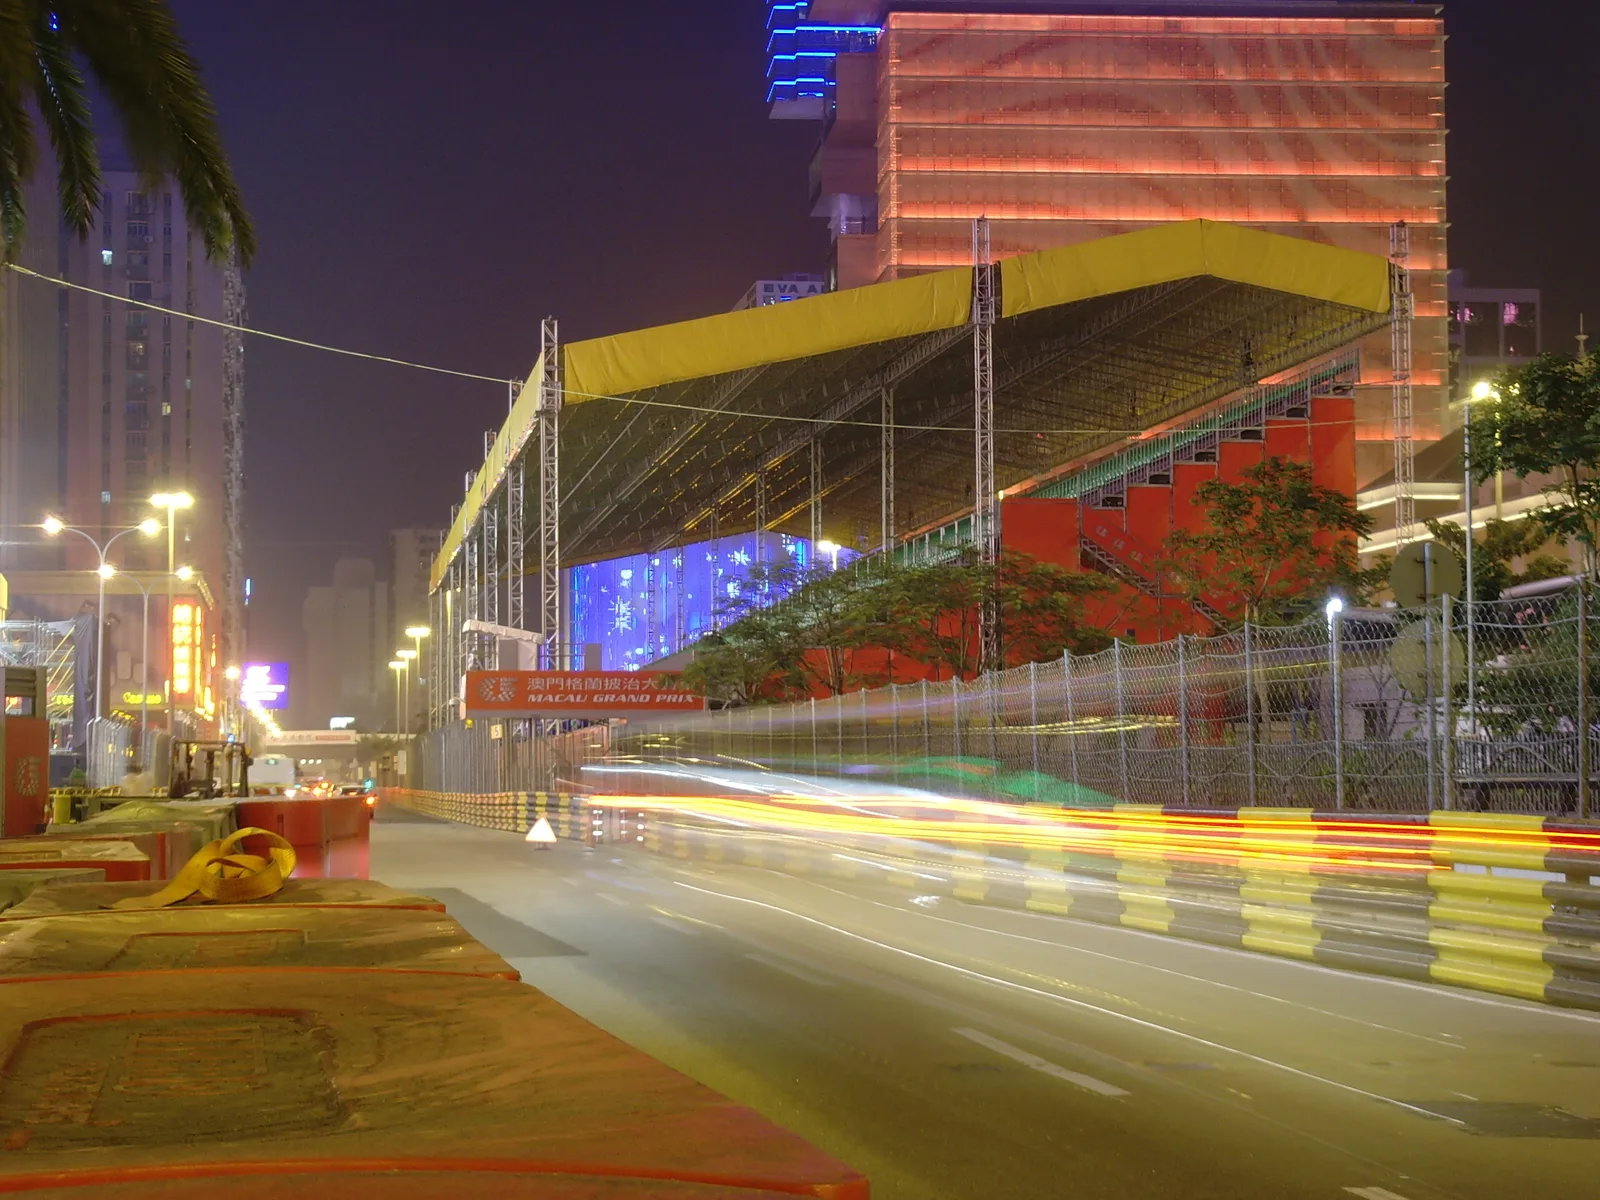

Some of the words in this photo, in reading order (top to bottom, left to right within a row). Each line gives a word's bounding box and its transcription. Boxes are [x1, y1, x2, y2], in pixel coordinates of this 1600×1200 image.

[763, 283, 798, 293] EVA
[527, 693, 588, 703] MACAU
[592, 693, 651, 703] GRAND
[655, 693, 694, 703] PRIX
